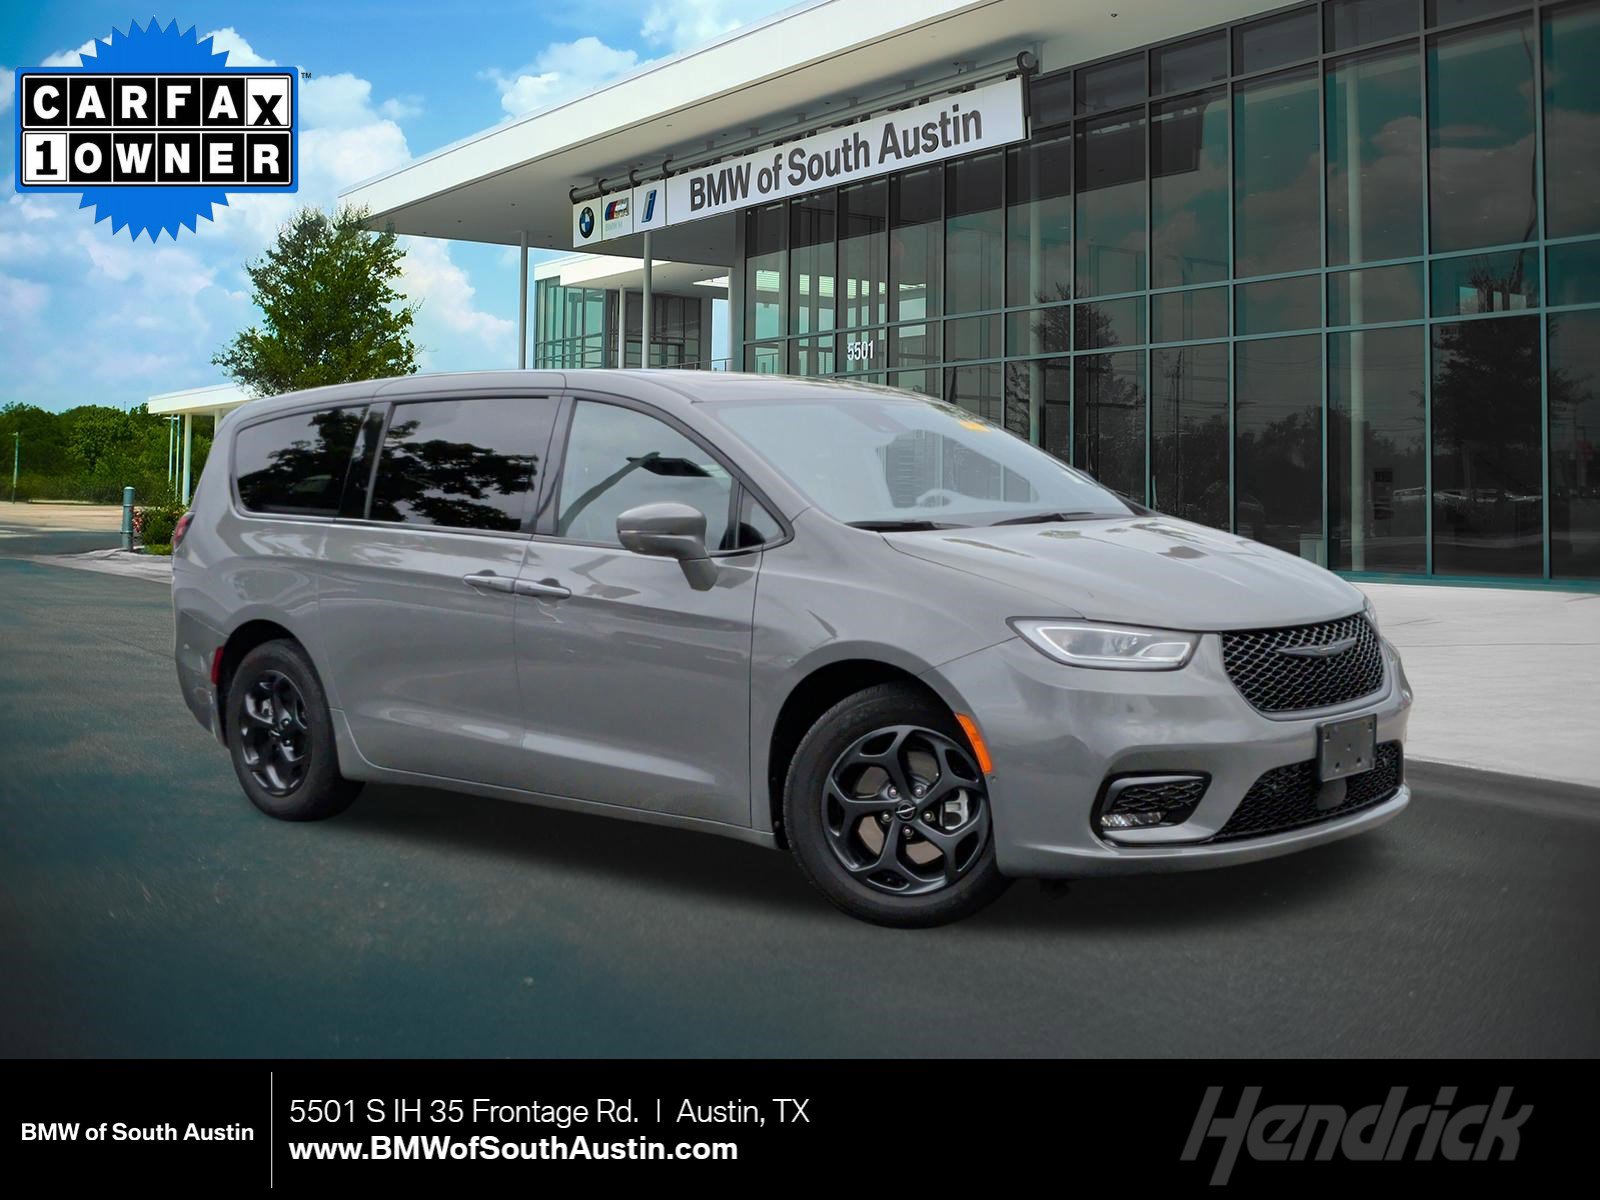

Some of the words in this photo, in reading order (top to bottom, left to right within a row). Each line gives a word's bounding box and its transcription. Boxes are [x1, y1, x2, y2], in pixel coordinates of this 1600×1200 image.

[690, 162, 751, 212] BMW
[757, 153, 783, 194] of
[787, 132, 870, 186] South
[878, 104, 983, 164] Austin
[847, 340, 874, 361] 5501
